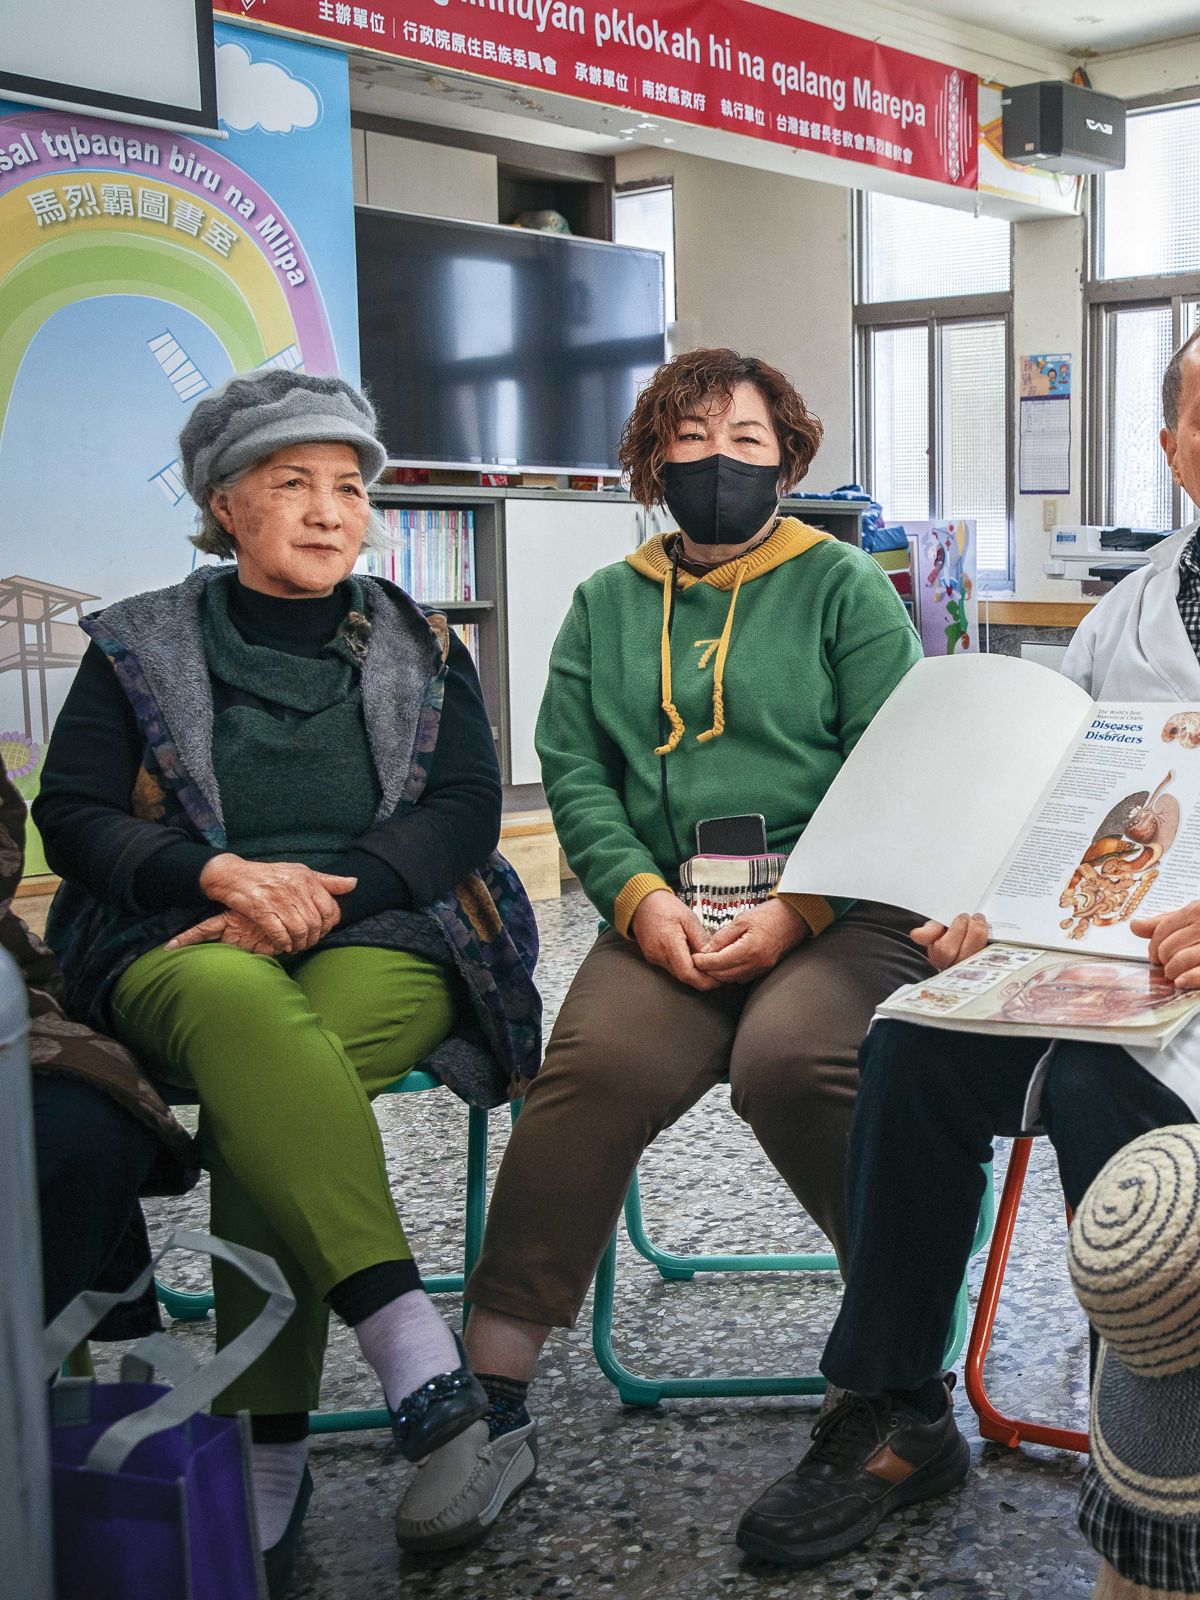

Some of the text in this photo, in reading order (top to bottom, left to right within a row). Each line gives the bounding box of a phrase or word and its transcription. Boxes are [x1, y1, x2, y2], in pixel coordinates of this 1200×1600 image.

[318, 0, 386, 34] 主辦單位
[402, 20, 558, 76] 行政院原住民族委員會
[574, 61, 629, 93] 承辦單位
[641, 79, 707, 112] 南投縣政府
[720, 98, 766, 128] 執行單位
[594, 8, 701, 64] pklokah
[709, 34, 732, 72] hi
[738, 51, 765, 82] na
[772, 61, 846, 112] qalang
[853, 76, 927, 129] Marepa
[0, 126, 306, 287] sal tqbaqan biru na Mlipa
[27, 181, 239, 258] 馬烈霸圖書室
[1084, 730, 1144, 745] Disorders
[1090, 719, 1144, 732] Diseases
